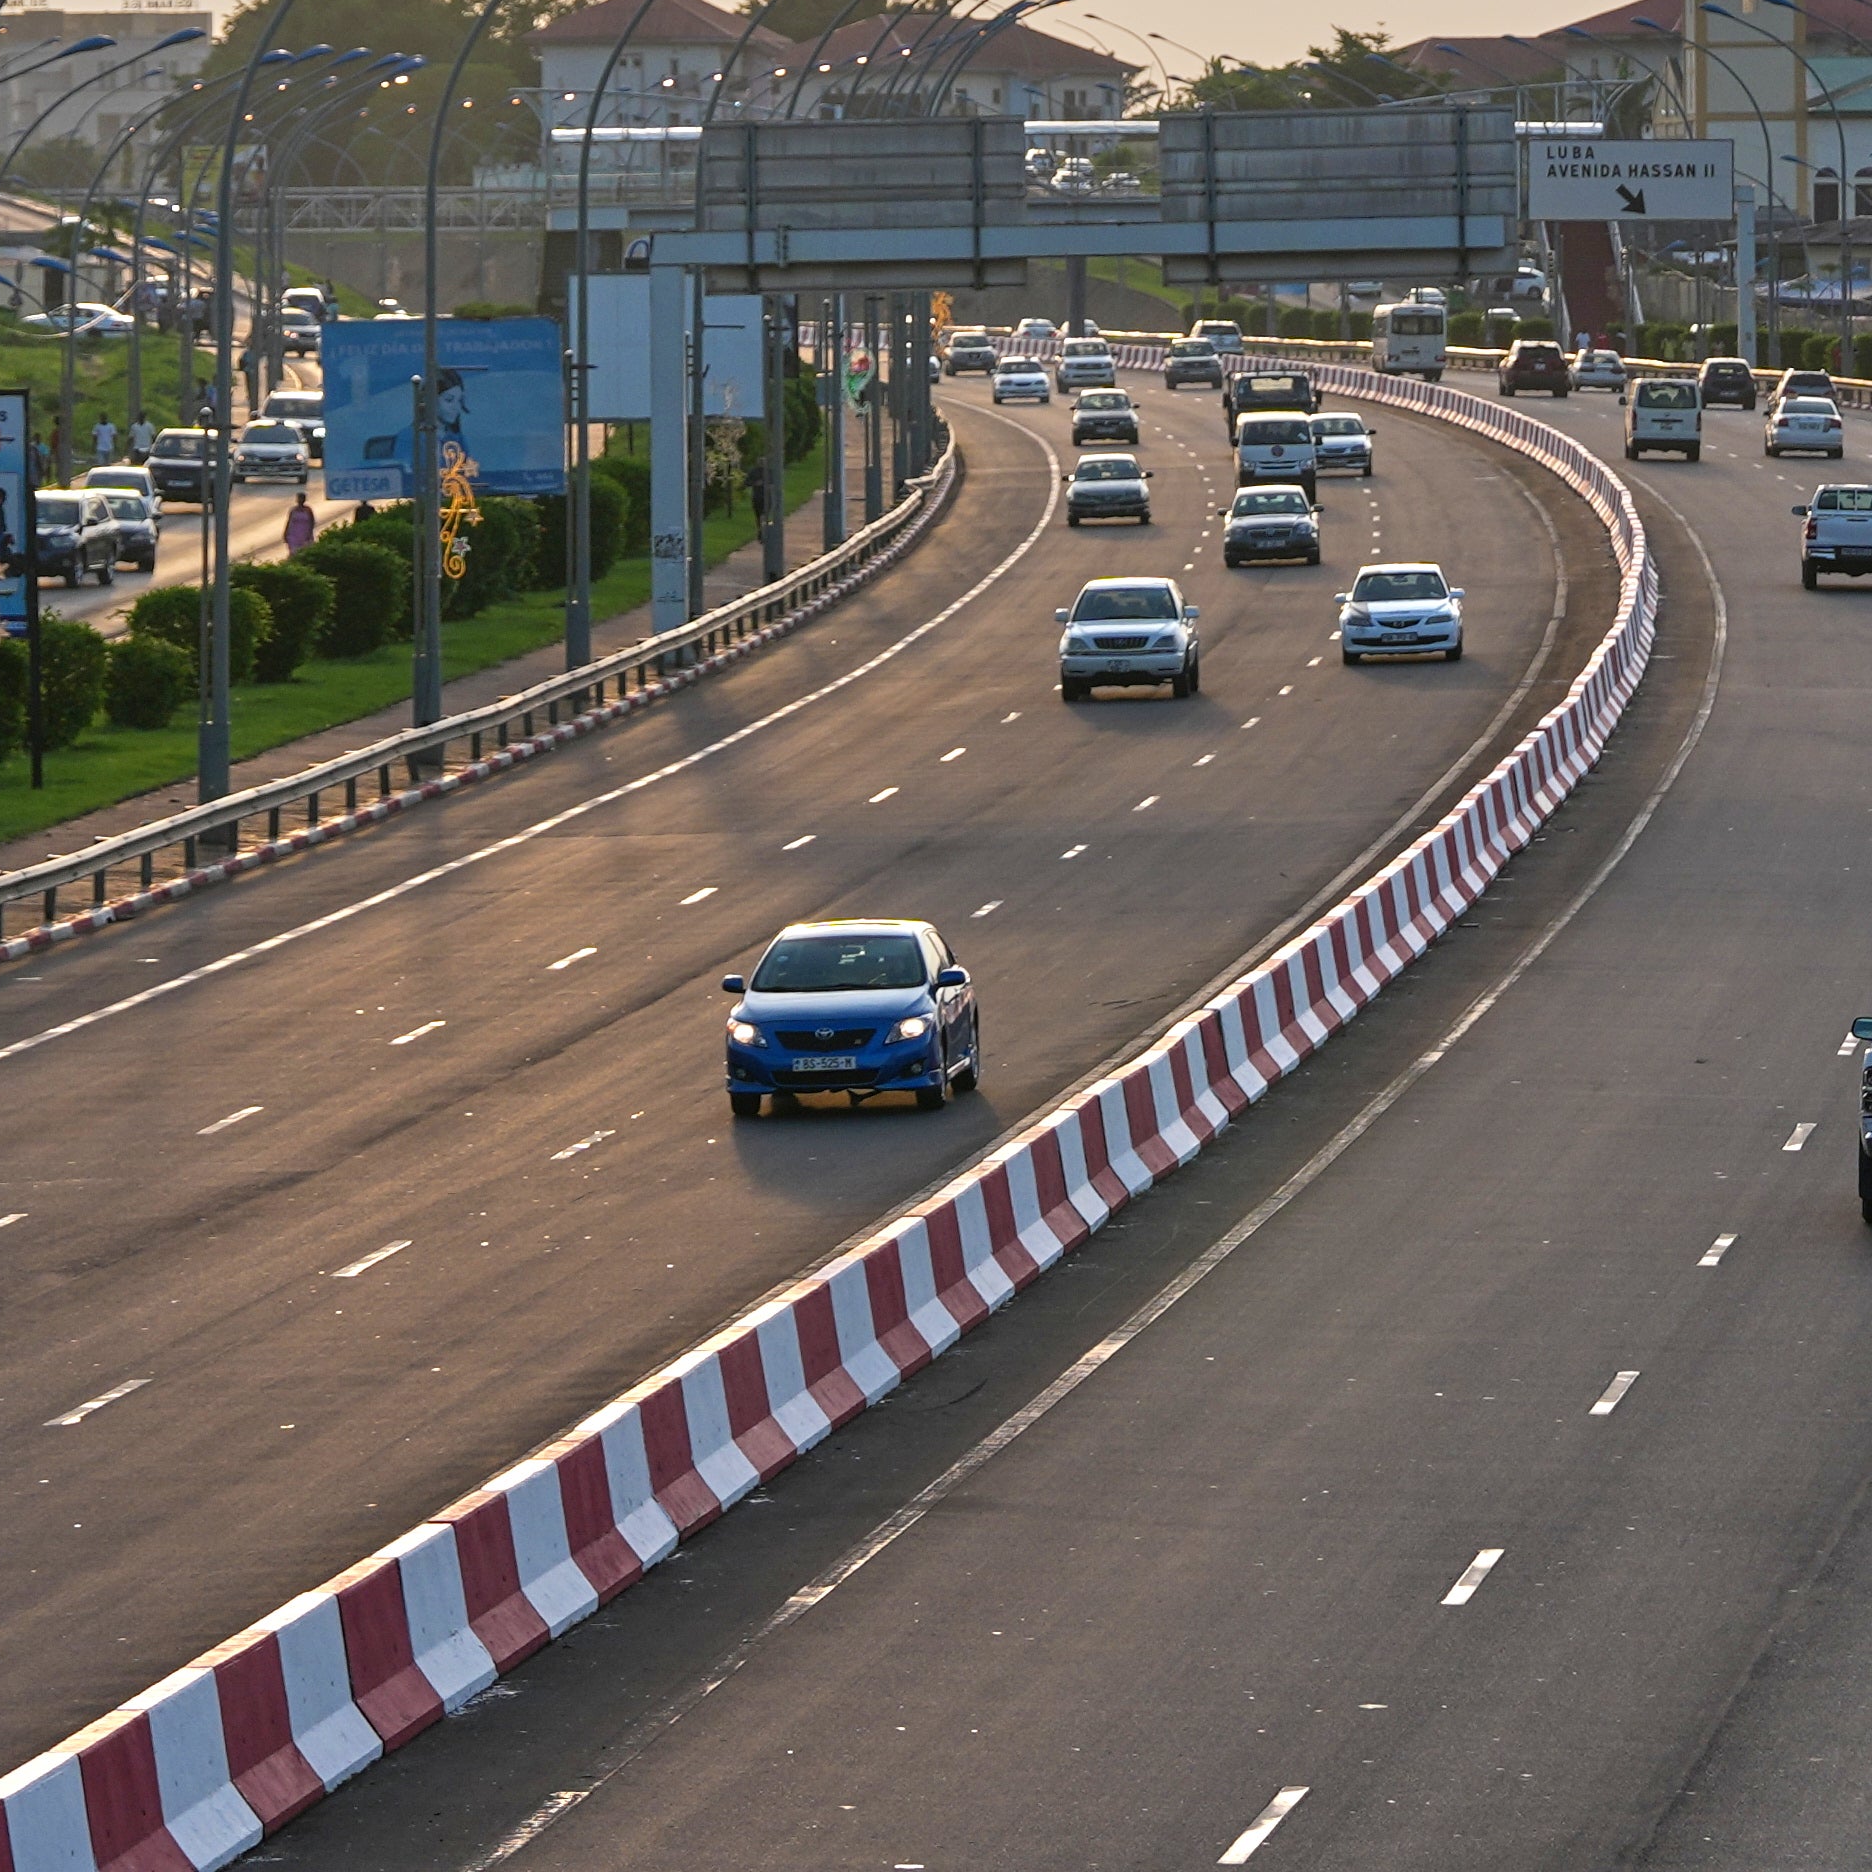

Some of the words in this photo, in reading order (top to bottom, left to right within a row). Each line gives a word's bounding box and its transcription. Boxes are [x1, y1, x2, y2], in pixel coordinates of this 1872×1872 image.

[1547, 146, 1595, 159] LUBA
[1547, 164, 1621, 178] AVENIDA
[1628, 164, 1696, 178] HASSAN
[1704, 164, 1715, 178] II
